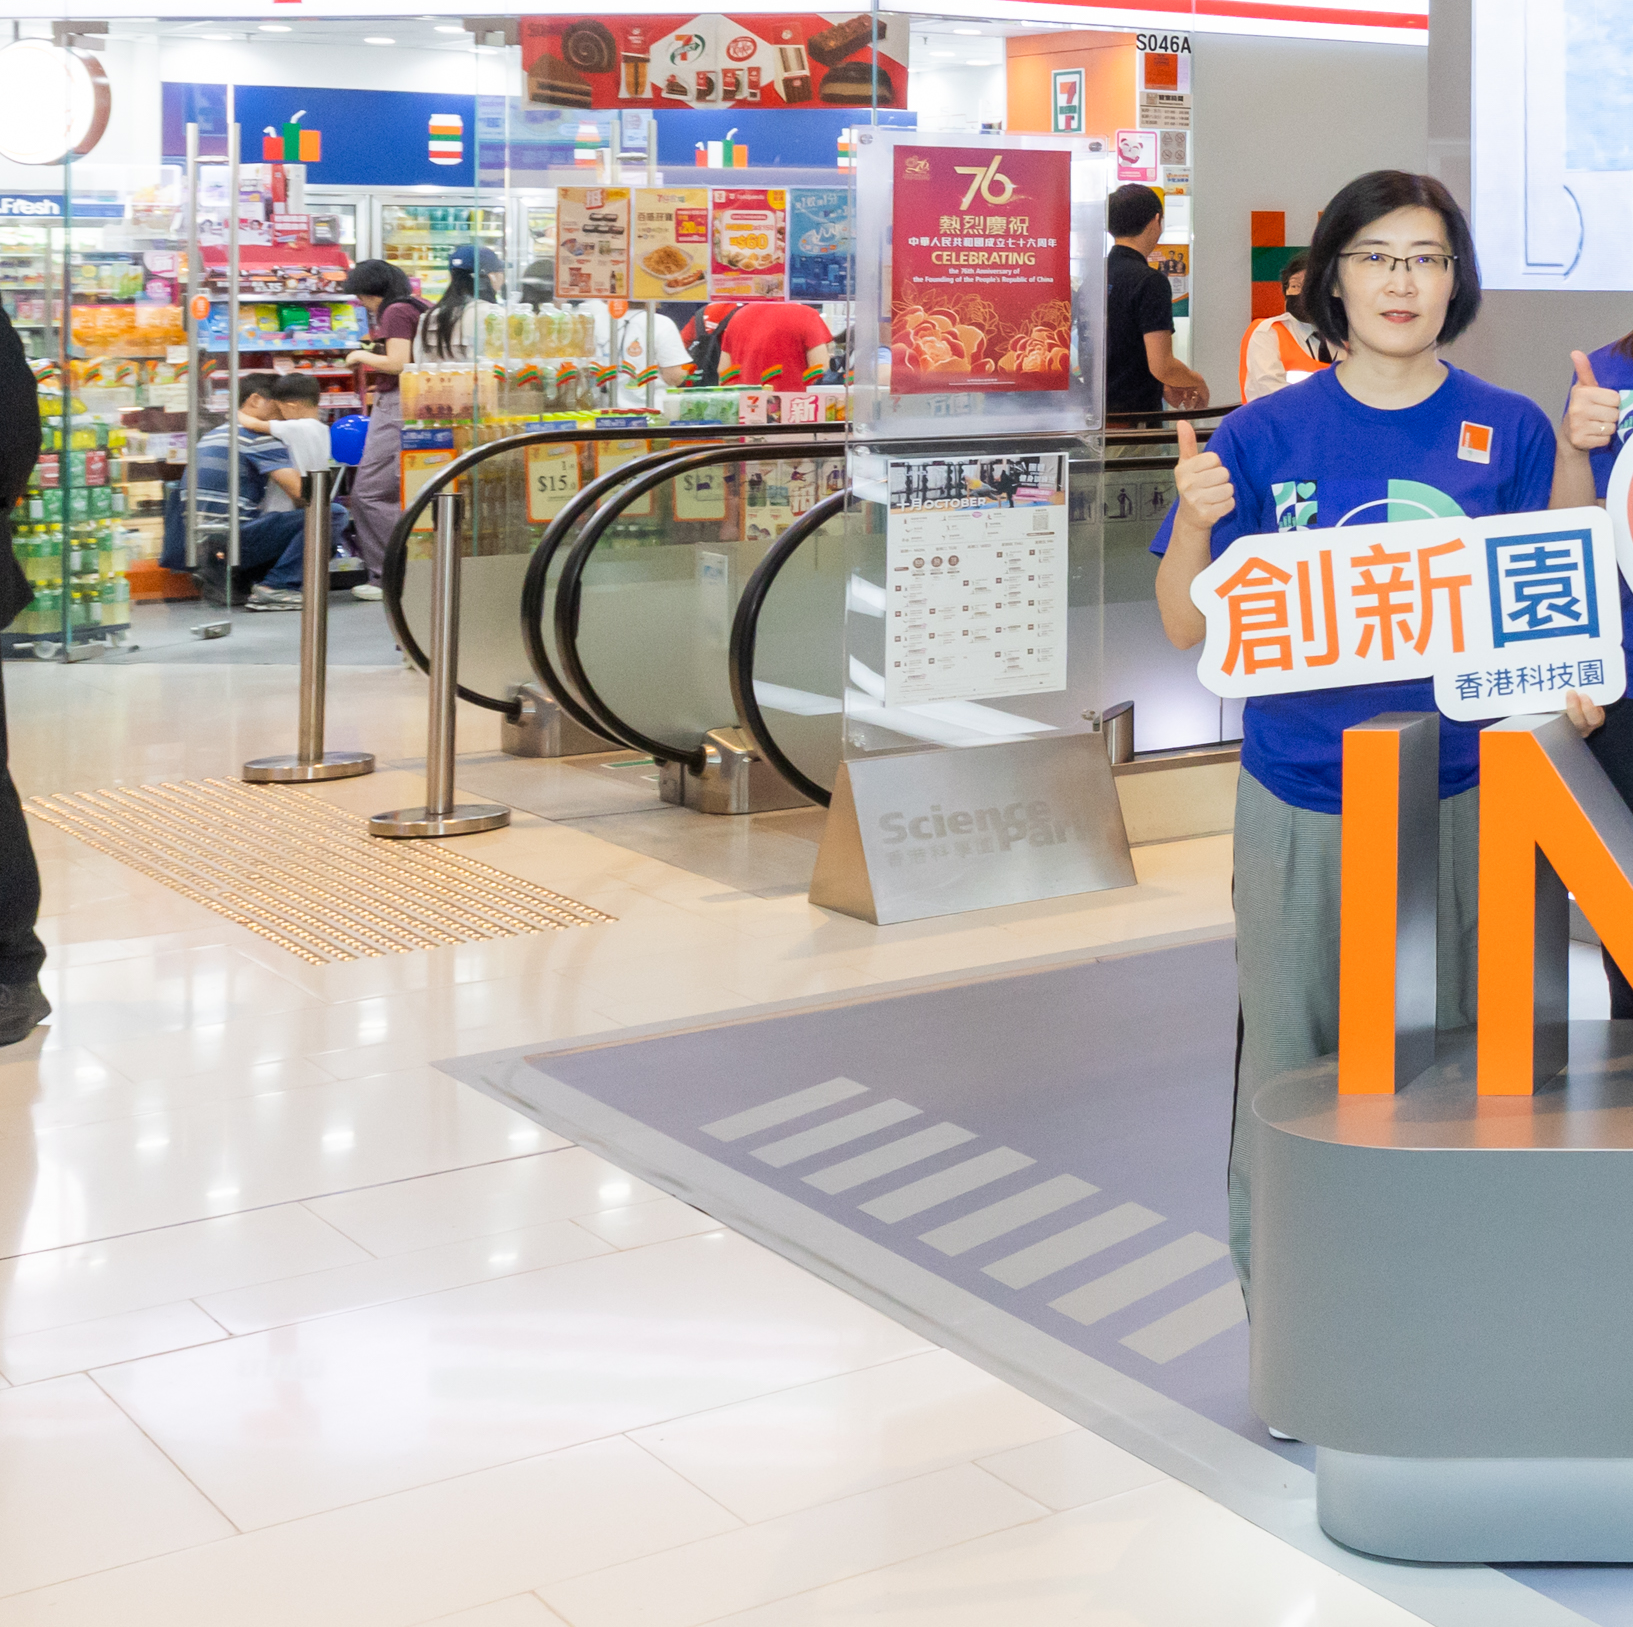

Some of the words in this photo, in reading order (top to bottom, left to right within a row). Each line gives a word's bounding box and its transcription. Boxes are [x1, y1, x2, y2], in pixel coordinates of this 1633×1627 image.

[1136, 34, 1191, 54] S046A
[954, 155, 1013, 211] 76
[939, 215, 1029, 235] 熱烈慶祝
[931, 251, 1036, 265] CELEBRATING
[925, 276, 954, 284] Founding
[1002, 276, 1027, 284] Republic
[976, 268, 1012, 276] Anniversary
[789, 395, 819, 423] 新
[924, 498, 987, 510] OCTOBER
[1214, 528, 1600, 677] 創新園
[1454, 658, 1605, 701] 香港科技園
[878, 800, 1050, 845] Science
